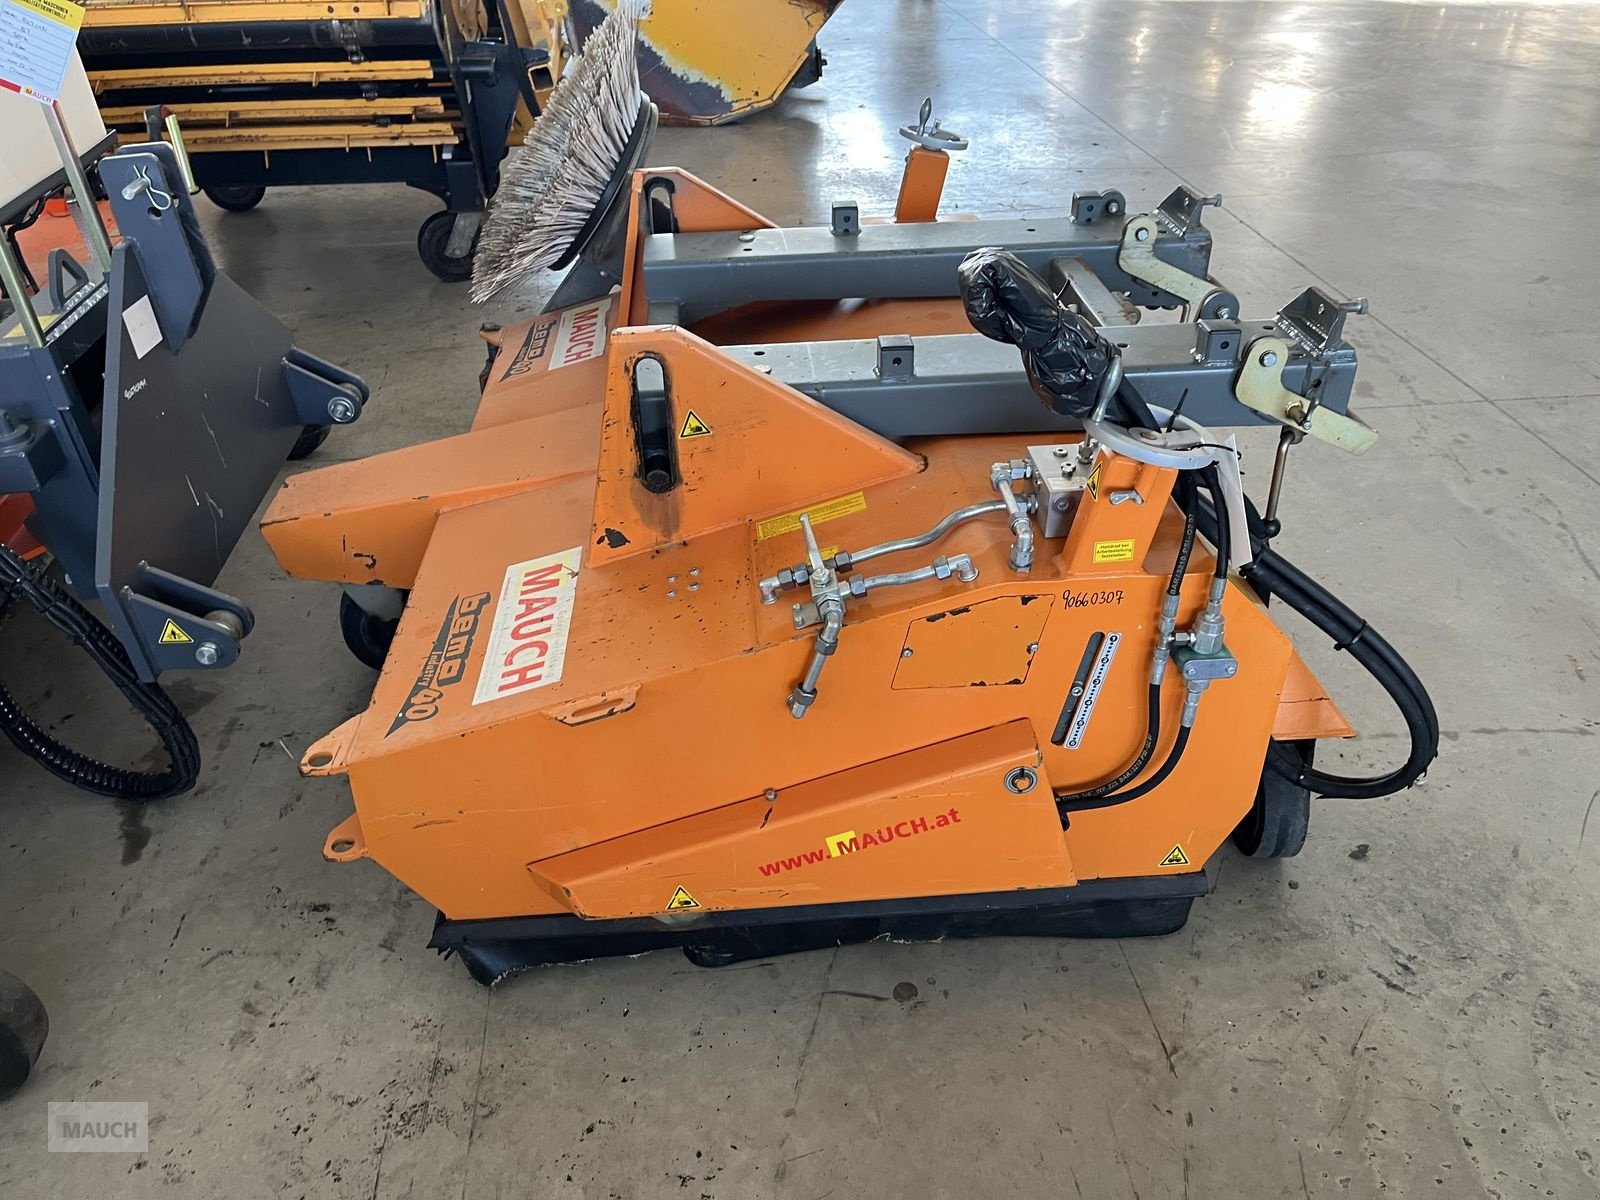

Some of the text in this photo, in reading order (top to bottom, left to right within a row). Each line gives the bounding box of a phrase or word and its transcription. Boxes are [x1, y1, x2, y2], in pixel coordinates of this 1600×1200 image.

[25, 88, 52, 104] MAUCH
[564, 307, 600, 364] MAUCH
[437, 592, 491, 687] bema
[498, 564, 563, 692] MAUCH
[405, 651, 443, 720] Industry 40
[758, 808, 962, 877] www.MAUCH.at
